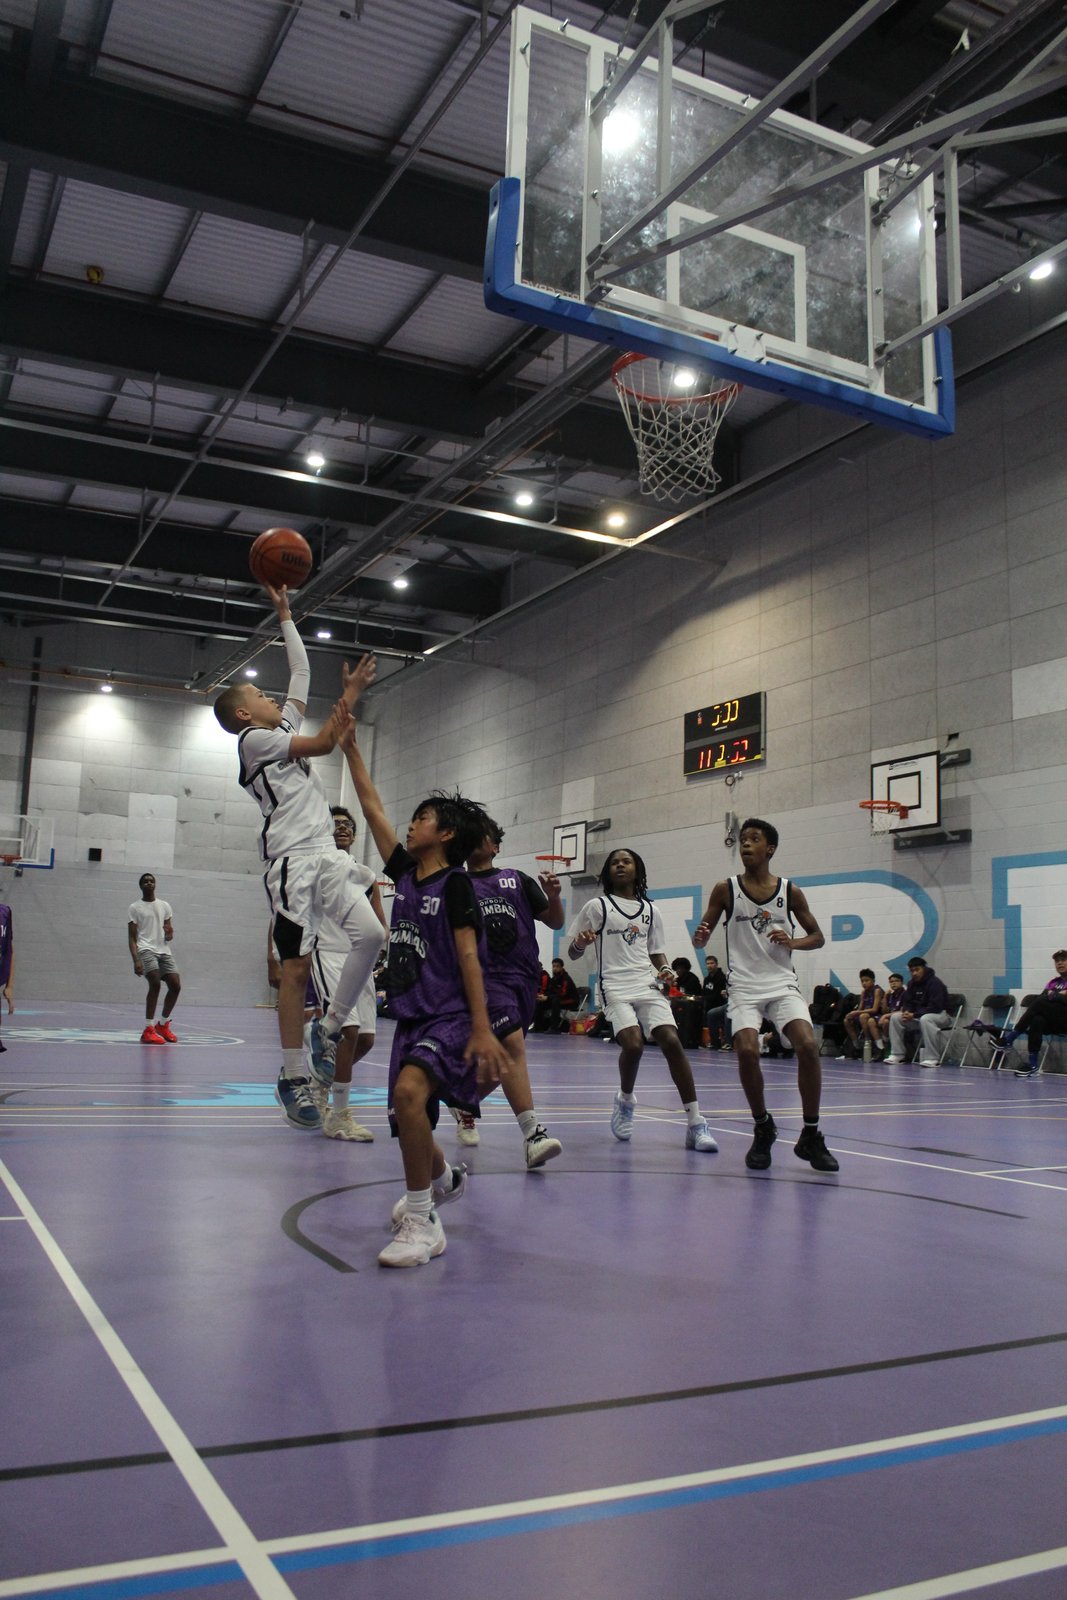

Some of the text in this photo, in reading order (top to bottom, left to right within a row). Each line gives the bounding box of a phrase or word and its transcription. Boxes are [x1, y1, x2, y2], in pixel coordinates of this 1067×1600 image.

[499, 877, 517, 889] 00
[420, 895, 441, 916] 30
[776, 896, 784, 908] 8
[641, 914, 650, 925] 12
